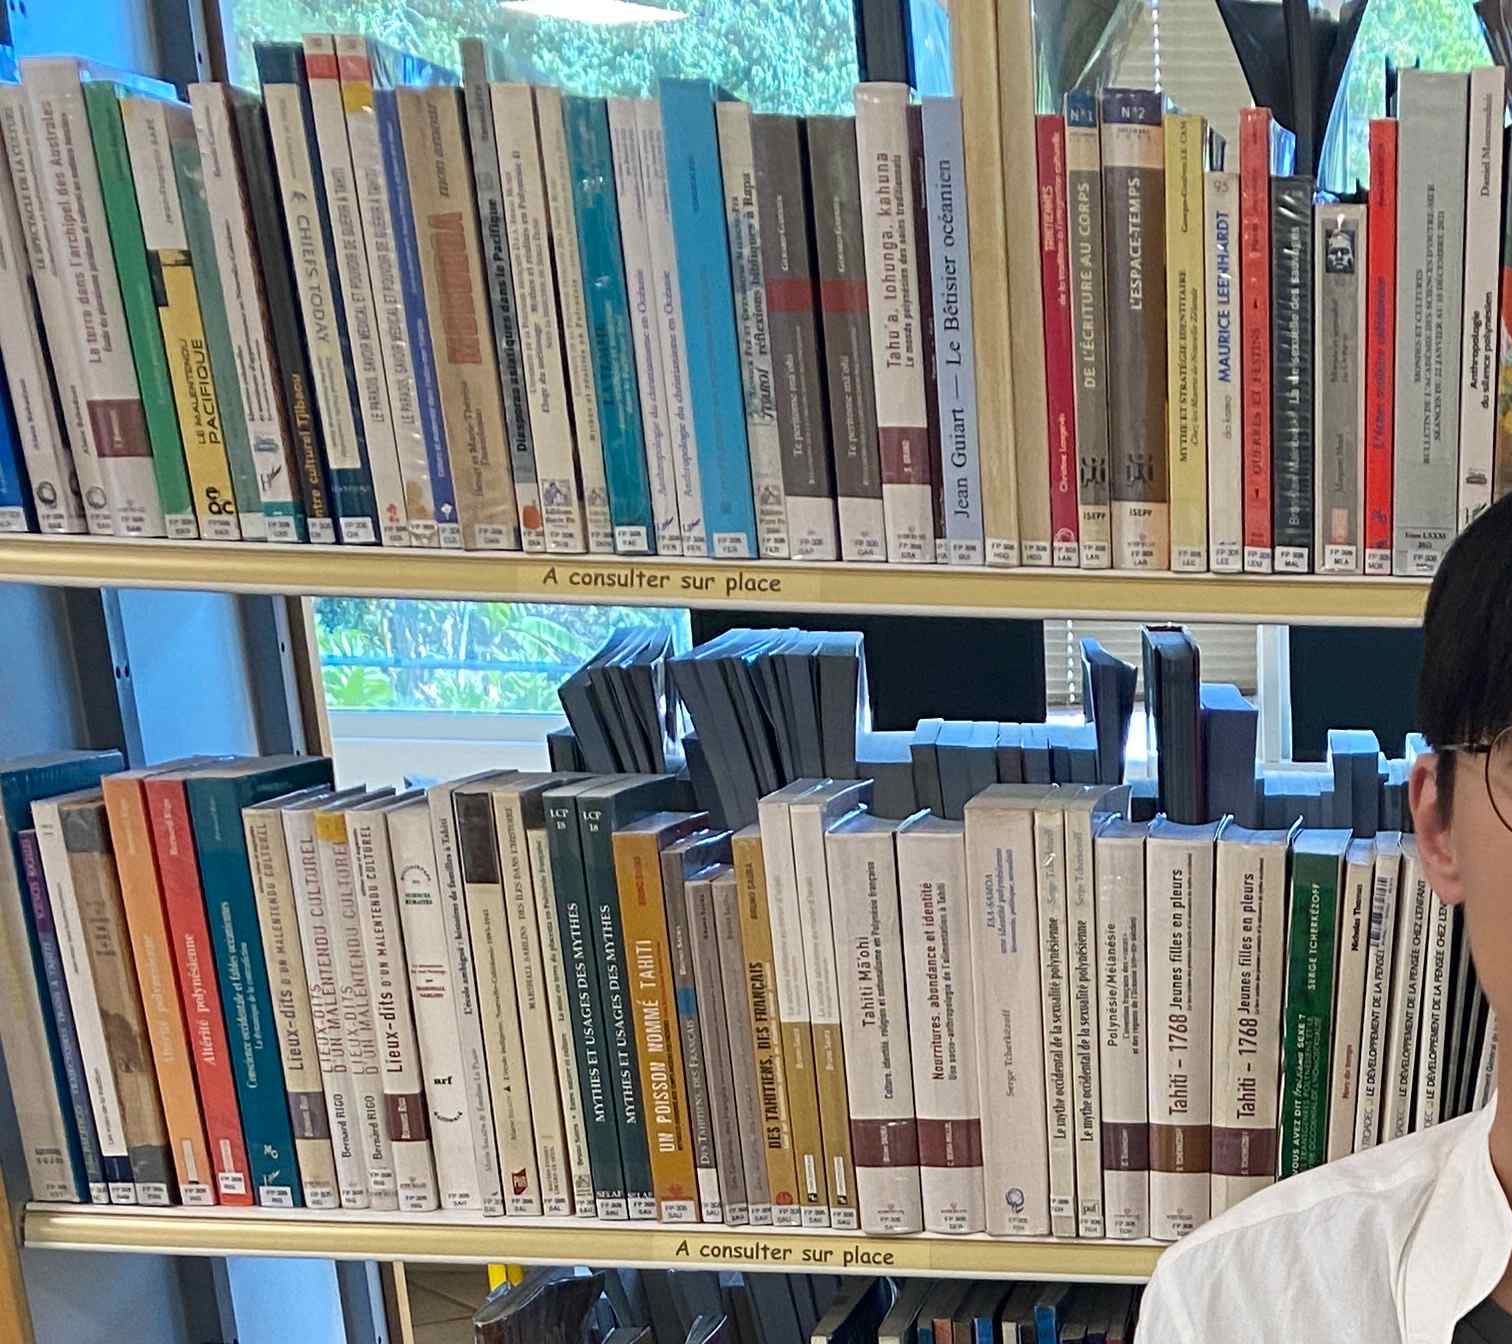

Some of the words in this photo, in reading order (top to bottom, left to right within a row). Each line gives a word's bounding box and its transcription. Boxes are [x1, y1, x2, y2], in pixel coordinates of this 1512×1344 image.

[937, 158, 955, 248] océanien
[1127, 176, 1144, 311] L'ESPACE-TEMPS
[941, 255, 961, 335] Bêtisier
[945, 340, 963, 367] Le
[1217, 310, 1232, 384] MAURICE
[191, 338, 221, 445] PACIFIQUE
[950, 406, 969, 469] Guiart
[953, 478, 970, 519] Jean
[543, 566, 558, 586] A
[565, 568, 670, 591] consulter
[680, 573, 716, 592] sur
[725, 570, 782, 597] place
[635, 939, 660, 989] TAHITI
[640, 998, 665, 1053] NOMMÉ
[649, 1061, 673, 1123] POISSON
[658, 1131, 676, 1153] UN
[675, 1241, 690, 1259] A
[699, 1240, 793, 1262] consulter
[802, 1246, 836, 1263] sur
[843, 1246, 895, 1269] place
